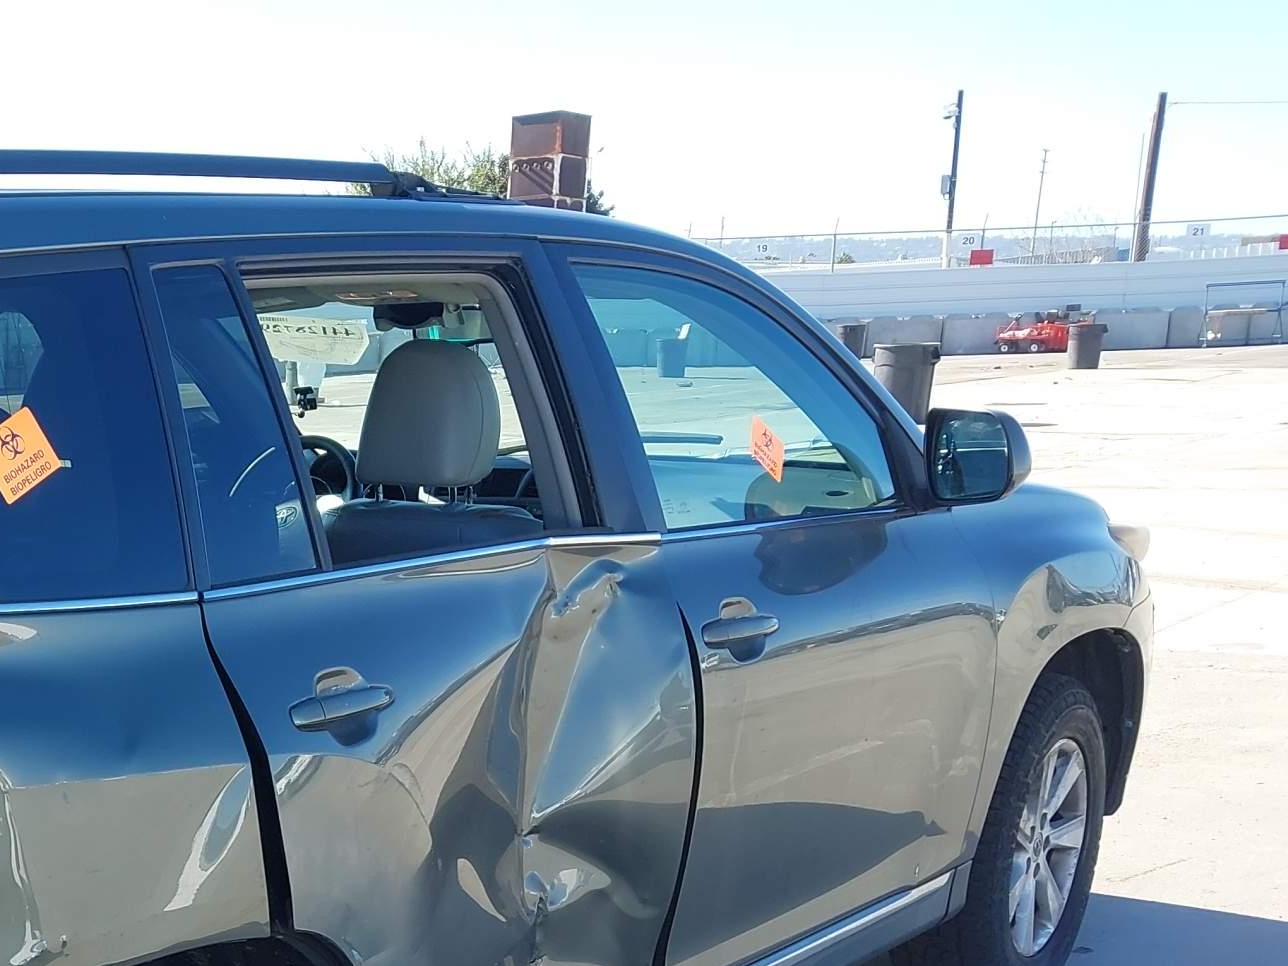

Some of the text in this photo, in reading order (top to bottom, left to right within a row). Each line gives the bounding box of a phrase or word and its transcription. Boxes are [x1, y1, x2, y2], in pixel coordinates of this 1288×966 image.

[1192, 227, 1204, 236] 21
[962, 236, 975, 245] 20
[757, 244, 768, 253] 19
[10, 461, 52, 496] BIOPELIGRO
